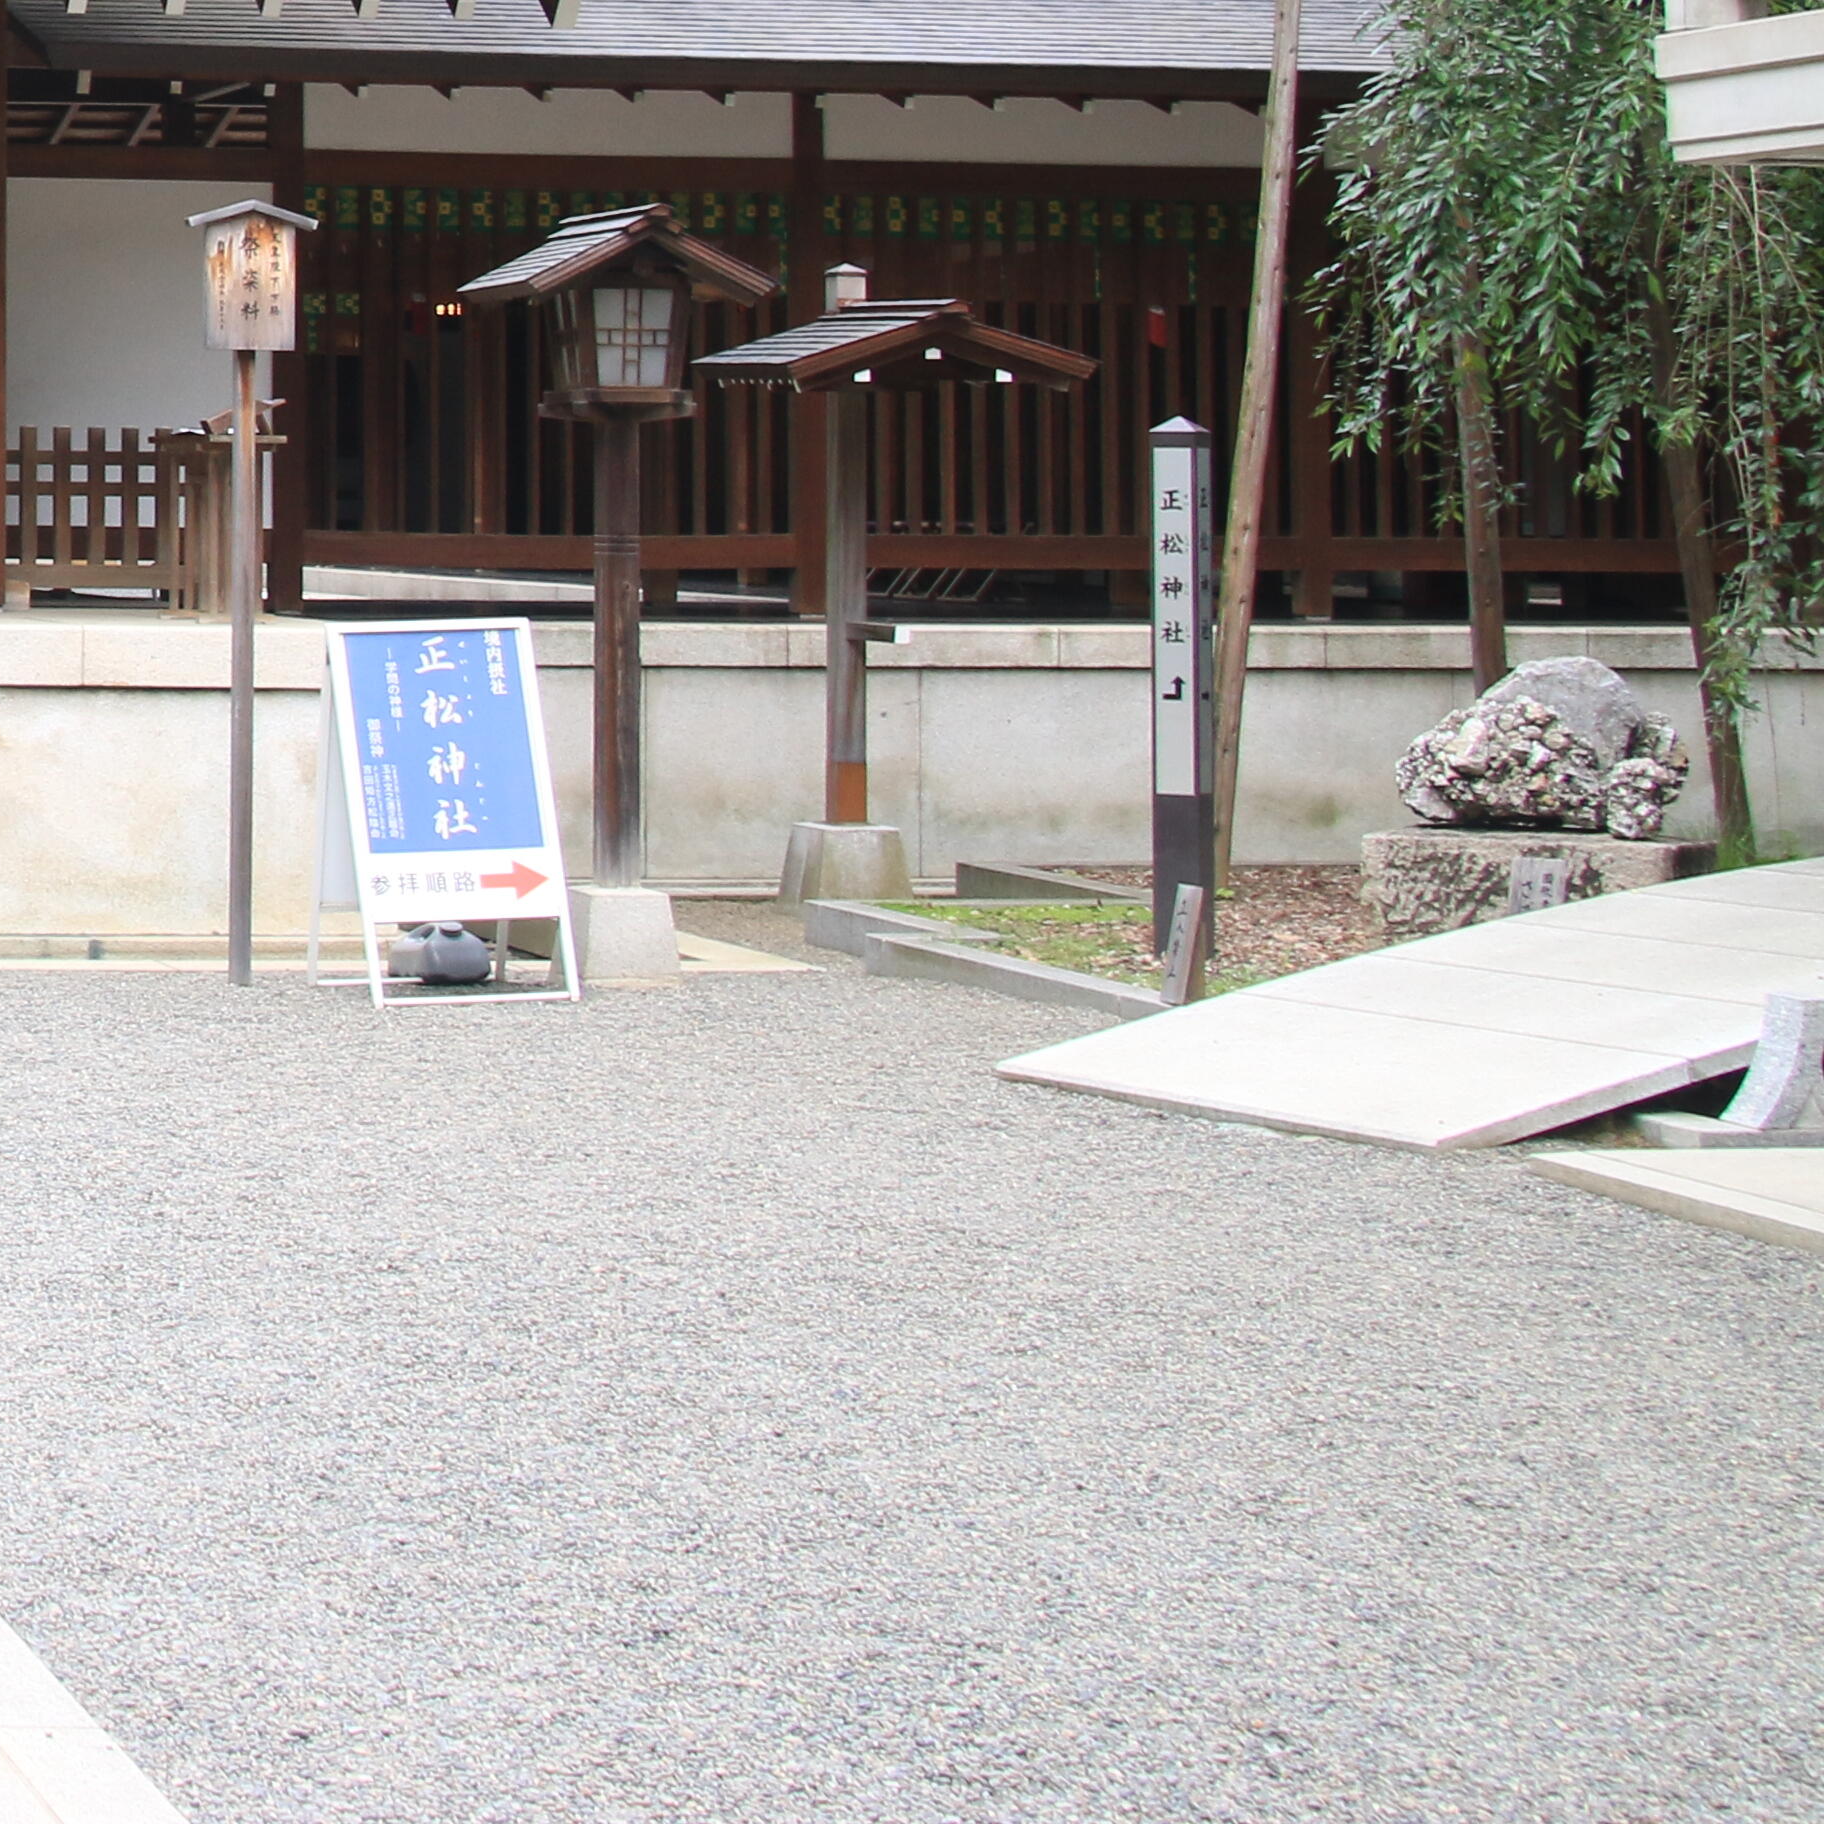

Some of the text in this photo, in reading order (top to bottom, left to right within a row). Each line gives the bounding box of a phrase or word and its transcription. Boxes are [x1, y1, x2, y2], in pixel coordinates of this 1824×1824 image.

[1158, 488, 1185, 644] 正松神社
[413, 634, 479, 841] 正松神社
[369, 870, 477, 896] 参拝順路
